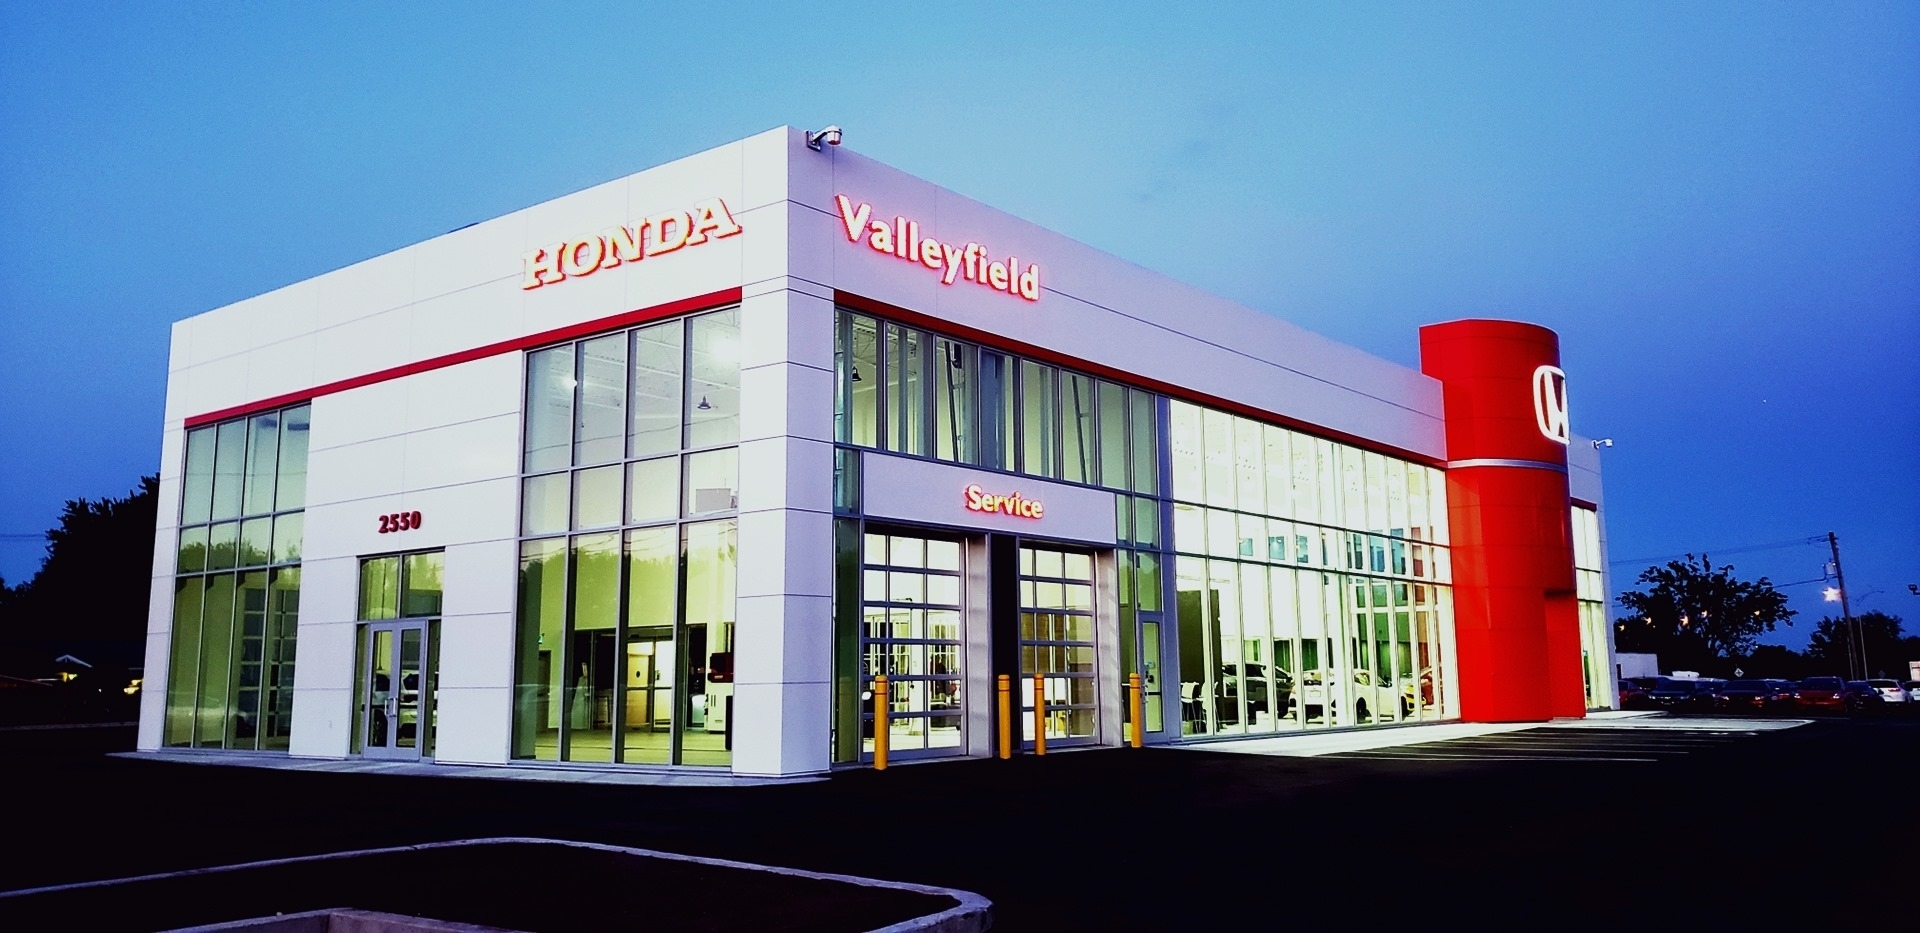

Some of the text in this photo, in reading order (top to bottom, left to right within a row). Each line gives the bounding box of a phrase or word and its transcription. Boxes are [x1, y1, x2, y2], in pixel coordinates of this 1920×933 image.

[520, 196, 743, 290] HONDA
[835, 194, 1039, 301] Valleyfield
[378, 510, 422, 534] 2550
[965, 484, 1044, 519] Service
